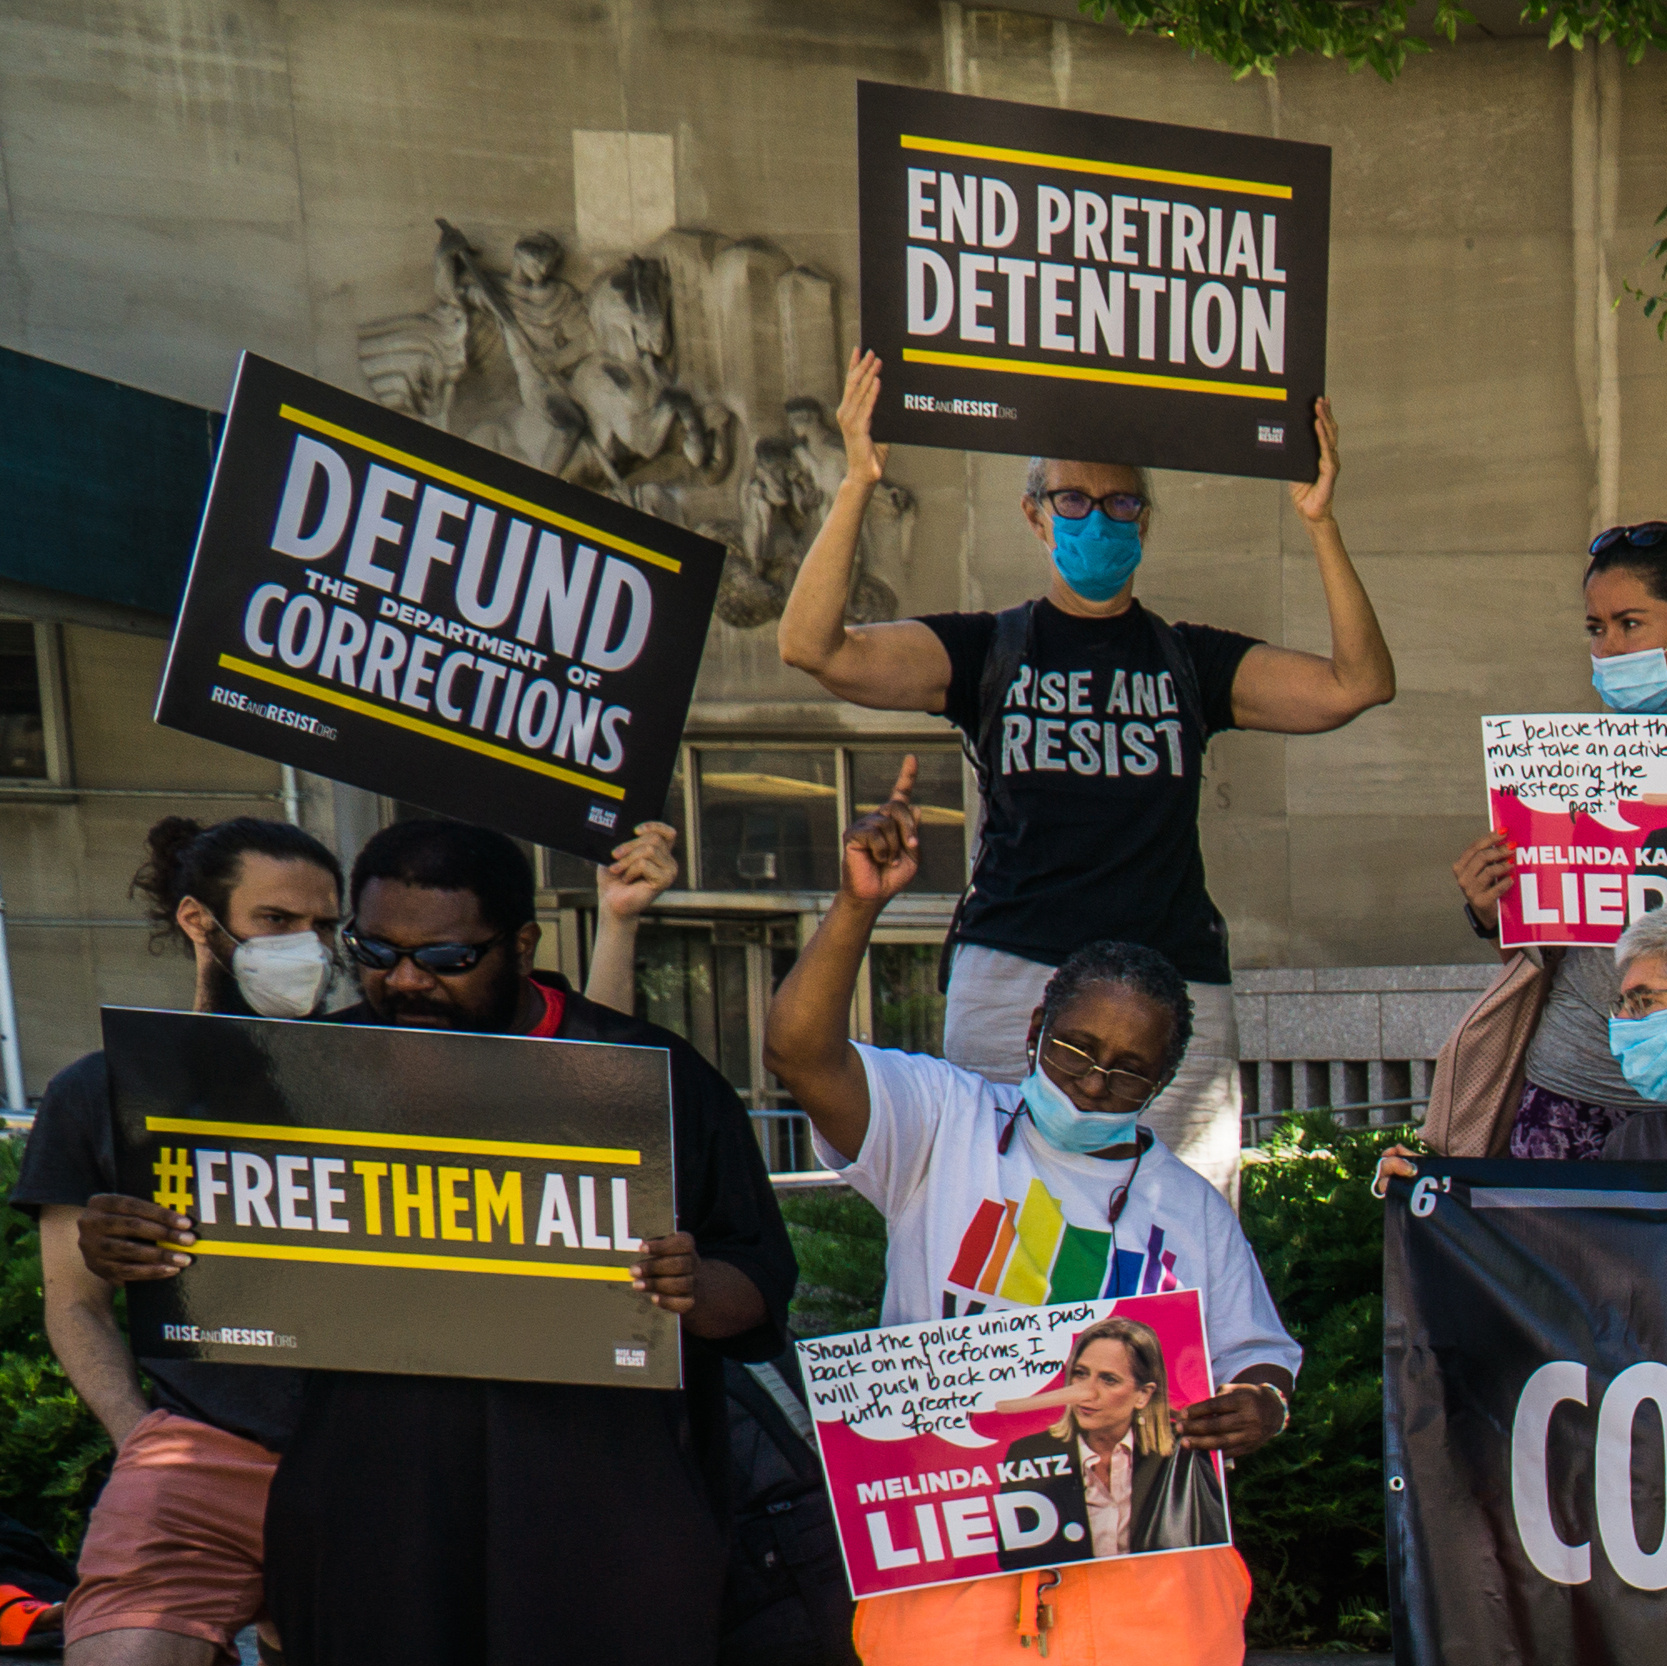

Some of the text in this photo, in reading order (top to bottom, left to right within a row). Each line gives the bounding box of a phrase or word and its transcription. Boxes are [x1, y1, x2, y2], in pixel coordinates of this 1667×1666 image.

[907, 167, 1286, 282] END PRETRIAL
[906, 245, 1285, 374] DETENTION
[270, 434, 652, 685] DEFUND
[305, 569, 601, 688] THE DEPARTMENT OF
[244, 583, 631, 772] CORRECTIONS
[1003, 664, 1093, 714] RISE
[1001, 714, 1182, 776] RESIST
[1486, 739, 1534, 758] must
[1537, 741, 1579, 757] take
[1585, 742, 1609, 757] an
[1522, 720, 1591, 742] believe
[1593, 718, 1639, 737] that
[1516, 845, 1629, 866] MELINDA
[876, 1333, 913, 1353] the
[919, 1325, 973, 1349] police
[978, 1313, 1041, 1336] unions
[1047, 1302, 1095, 1330] push
[808, 1359, 867, 1382] back
[872, 1359, 897, 1373] on
[900, 1346, 934, 1372] my
[813, 1381, 859, 1406] will
[867, 1375, 919, 1402] push
[926, 1366, 985, 1391] back
[988, 1366, 1016, 1381] on
[841, 1392, 980, 1427] with greater
[856, 1454, 1072, 1504] MELINDA KATZ
[866, 1491, 1085, 1571] LIED.
